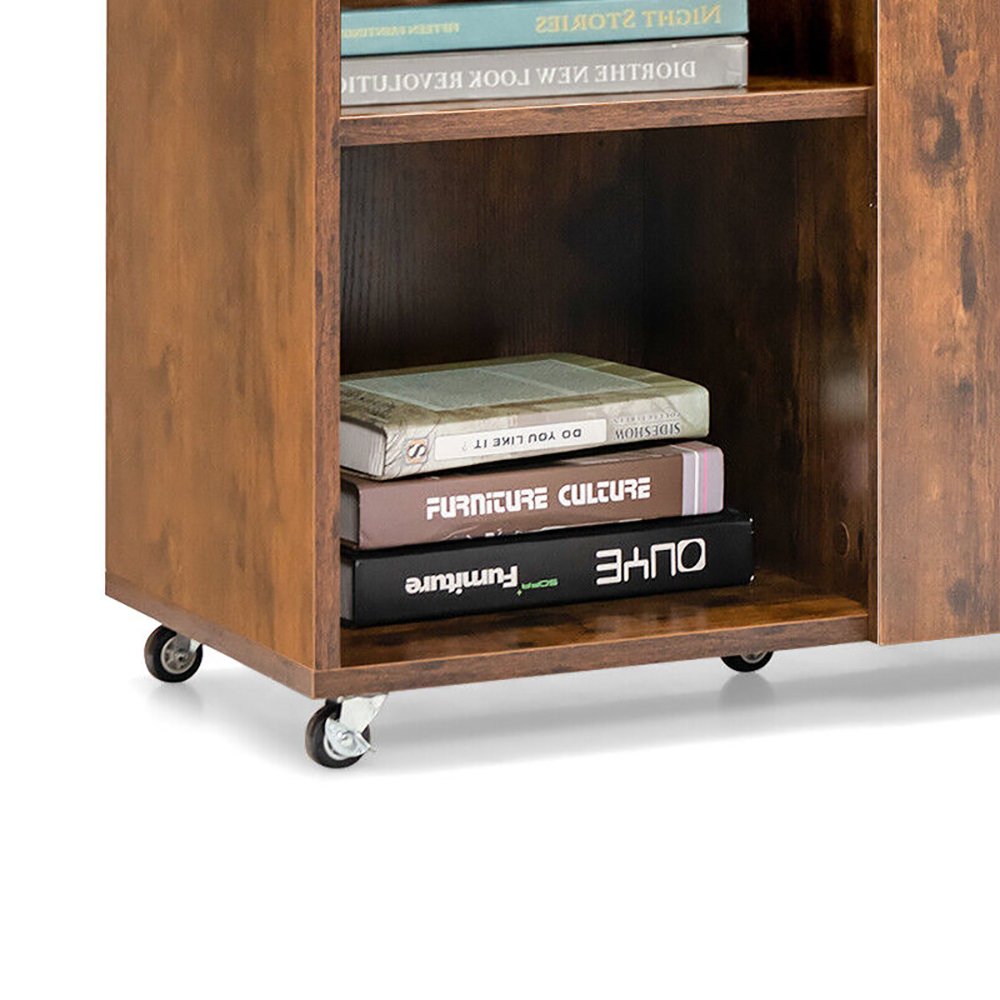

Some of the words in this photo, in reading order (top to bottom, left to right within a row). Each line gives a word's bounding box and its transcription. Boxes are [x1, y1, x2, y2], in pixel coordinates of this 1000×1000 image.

[528, 430, 556, 442] YOU
[561, 428, 583, 438] DO
[614, 422, 682, 441] SIDESHOW
[474, 438, 488, 449] IT
[493, 435, 523, 447] LIKE
[557, 476, 651, 507] CULTURE
[404, 565, 519, 596] Furniture
